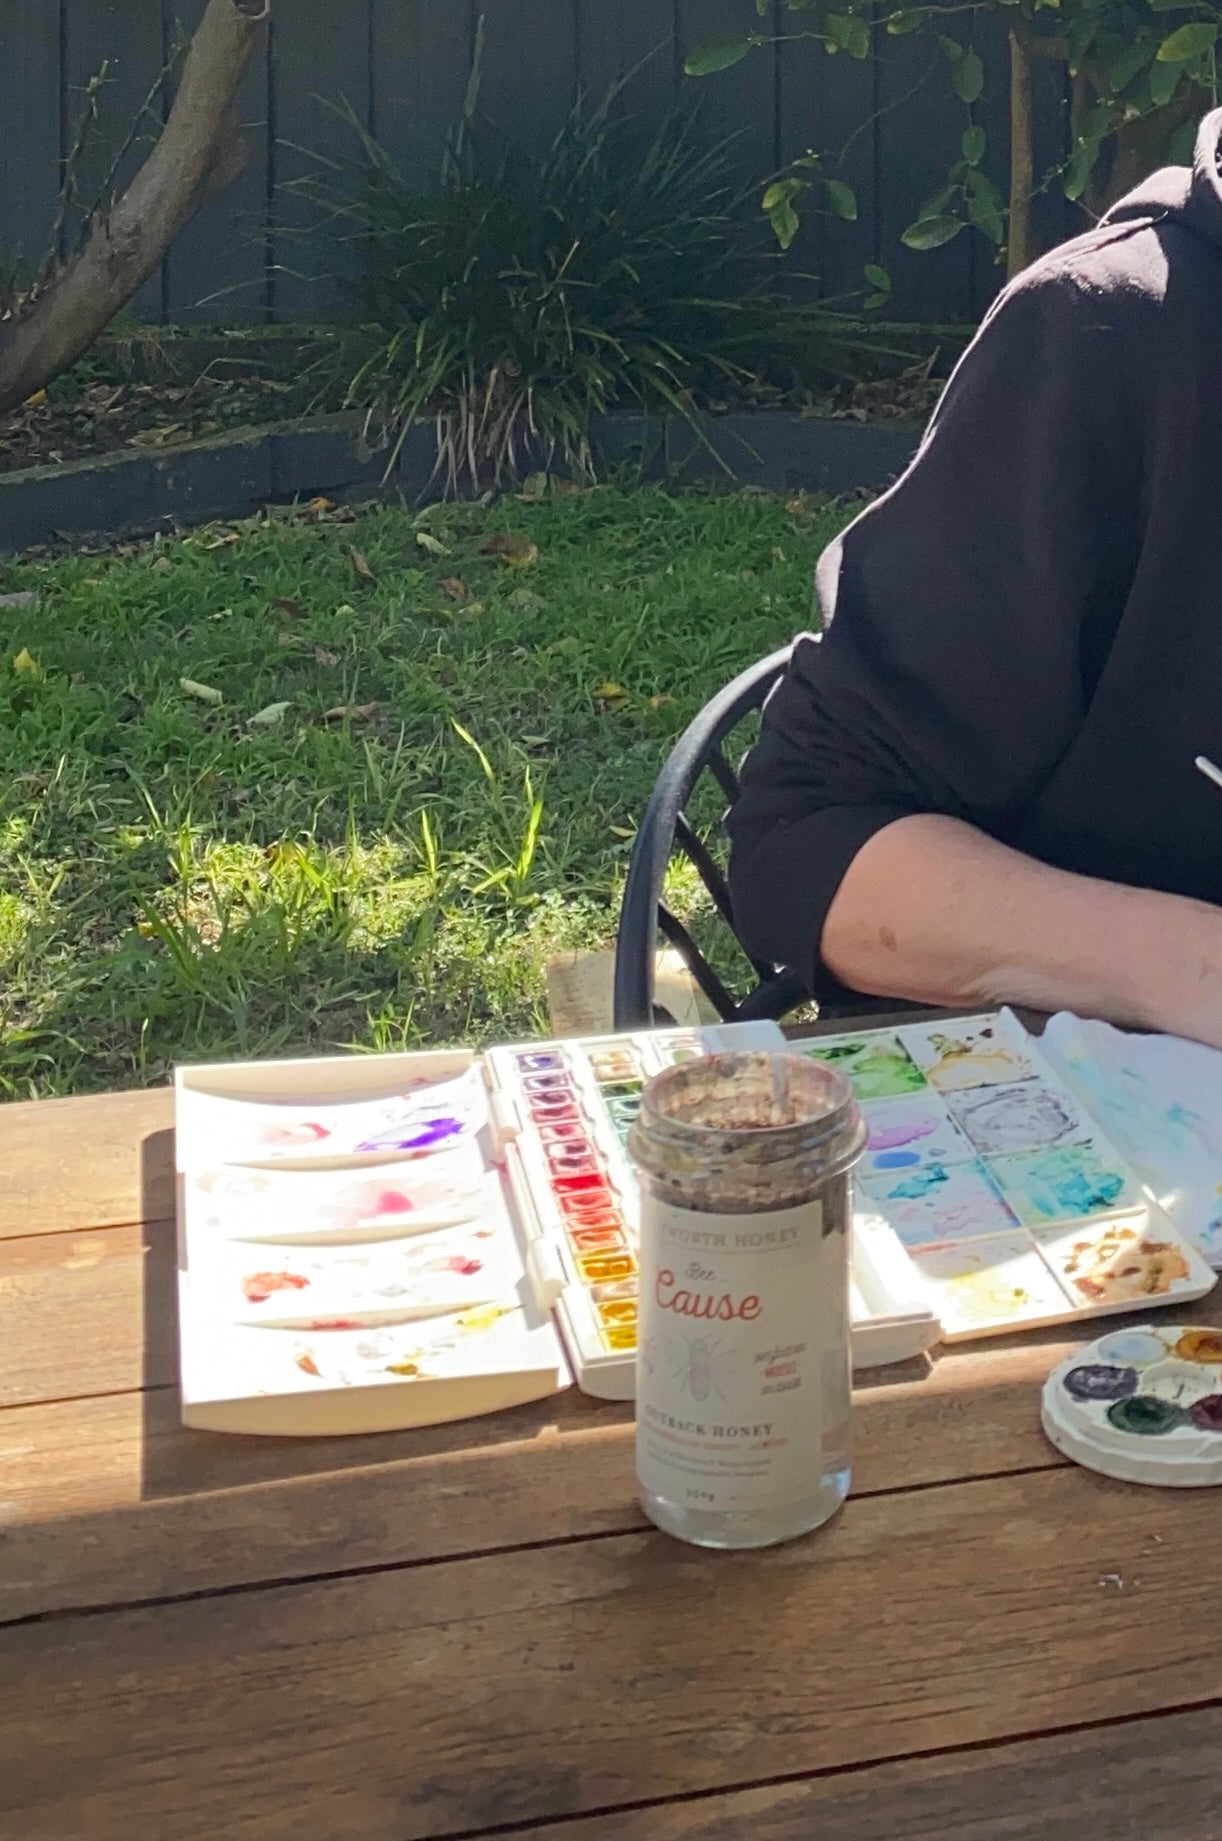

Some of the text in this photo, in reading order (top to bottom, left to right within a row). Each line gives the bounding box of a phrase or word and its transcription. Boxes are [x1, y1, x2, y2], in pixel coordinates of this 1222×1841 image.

[735, 1225, 800, 1248] HONEY
[655, 1267, 764, 1321] Cause
[712, 1422, 775, 1438] HONEY
